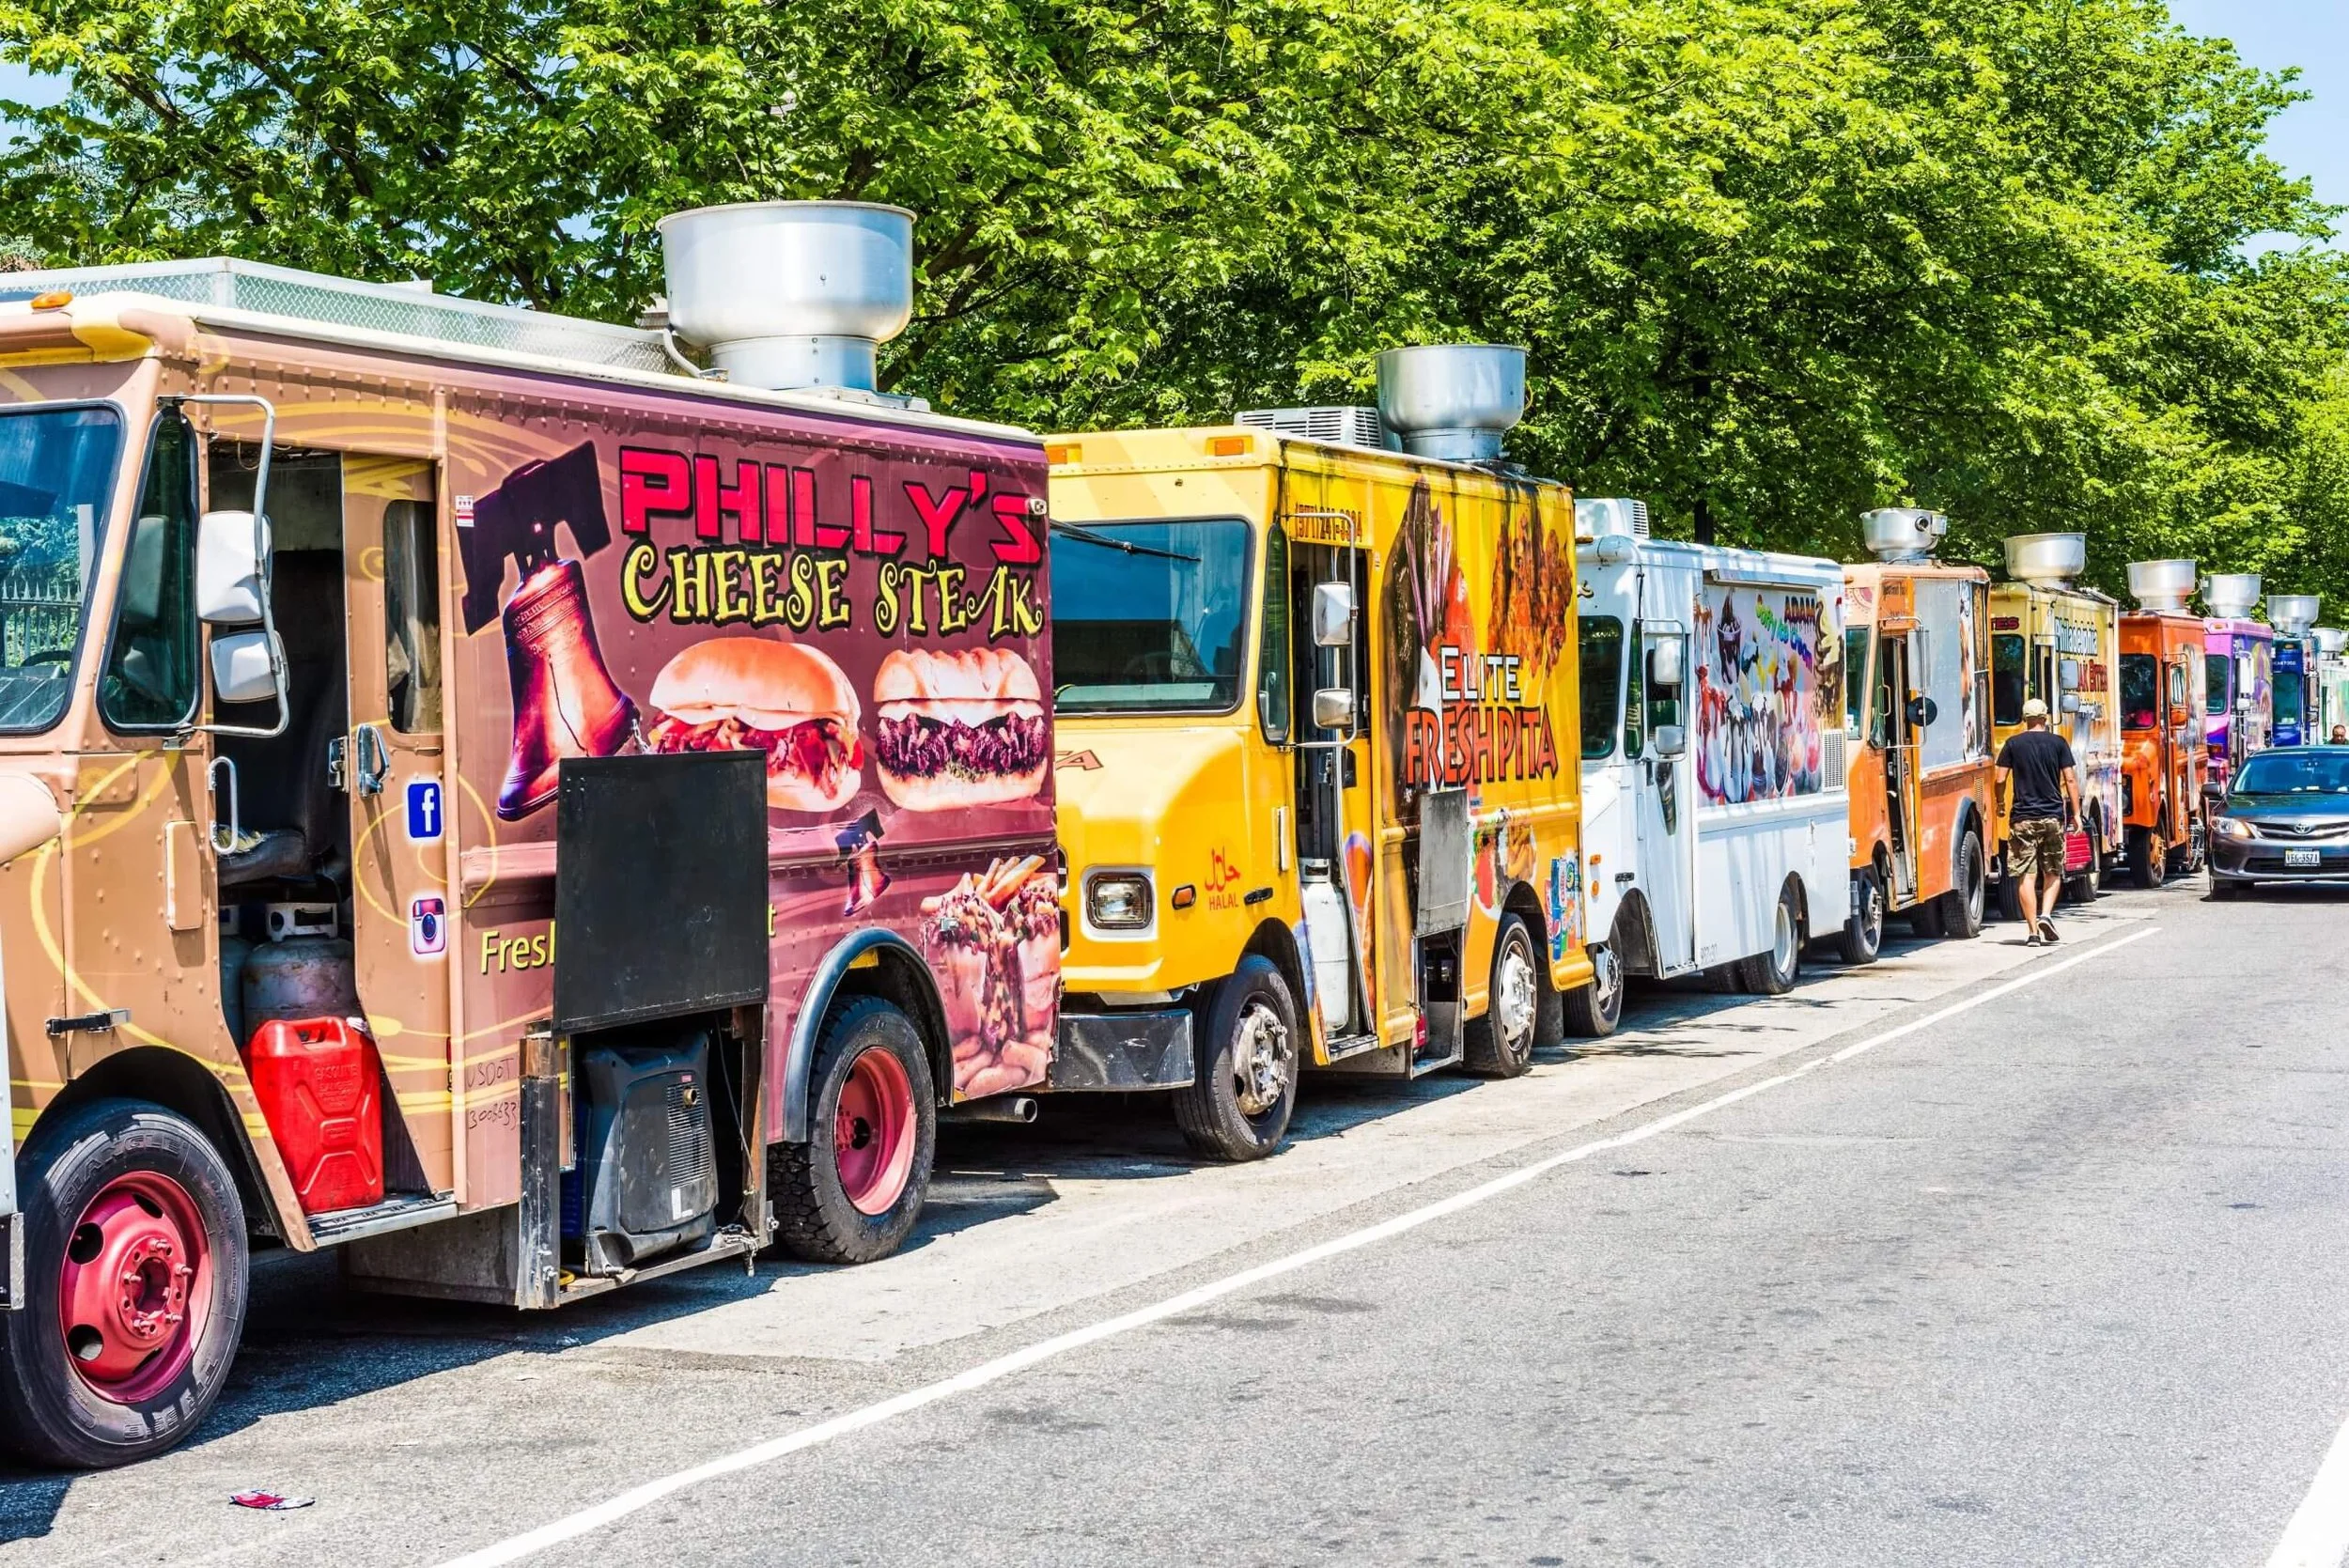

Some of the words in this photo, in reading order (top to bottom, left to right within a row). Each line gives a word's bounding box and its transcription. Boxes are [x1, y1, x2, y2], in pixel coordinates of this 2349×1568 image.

[619, 445, 1043, 566] PHILLY'S
[620, 542, 852, 629] CHEESE
[874, 558, 1044, 640] STEAK
[1440, 644, 1521, 702] ELITE
[1209, 892, 1239, 911] HALAL
